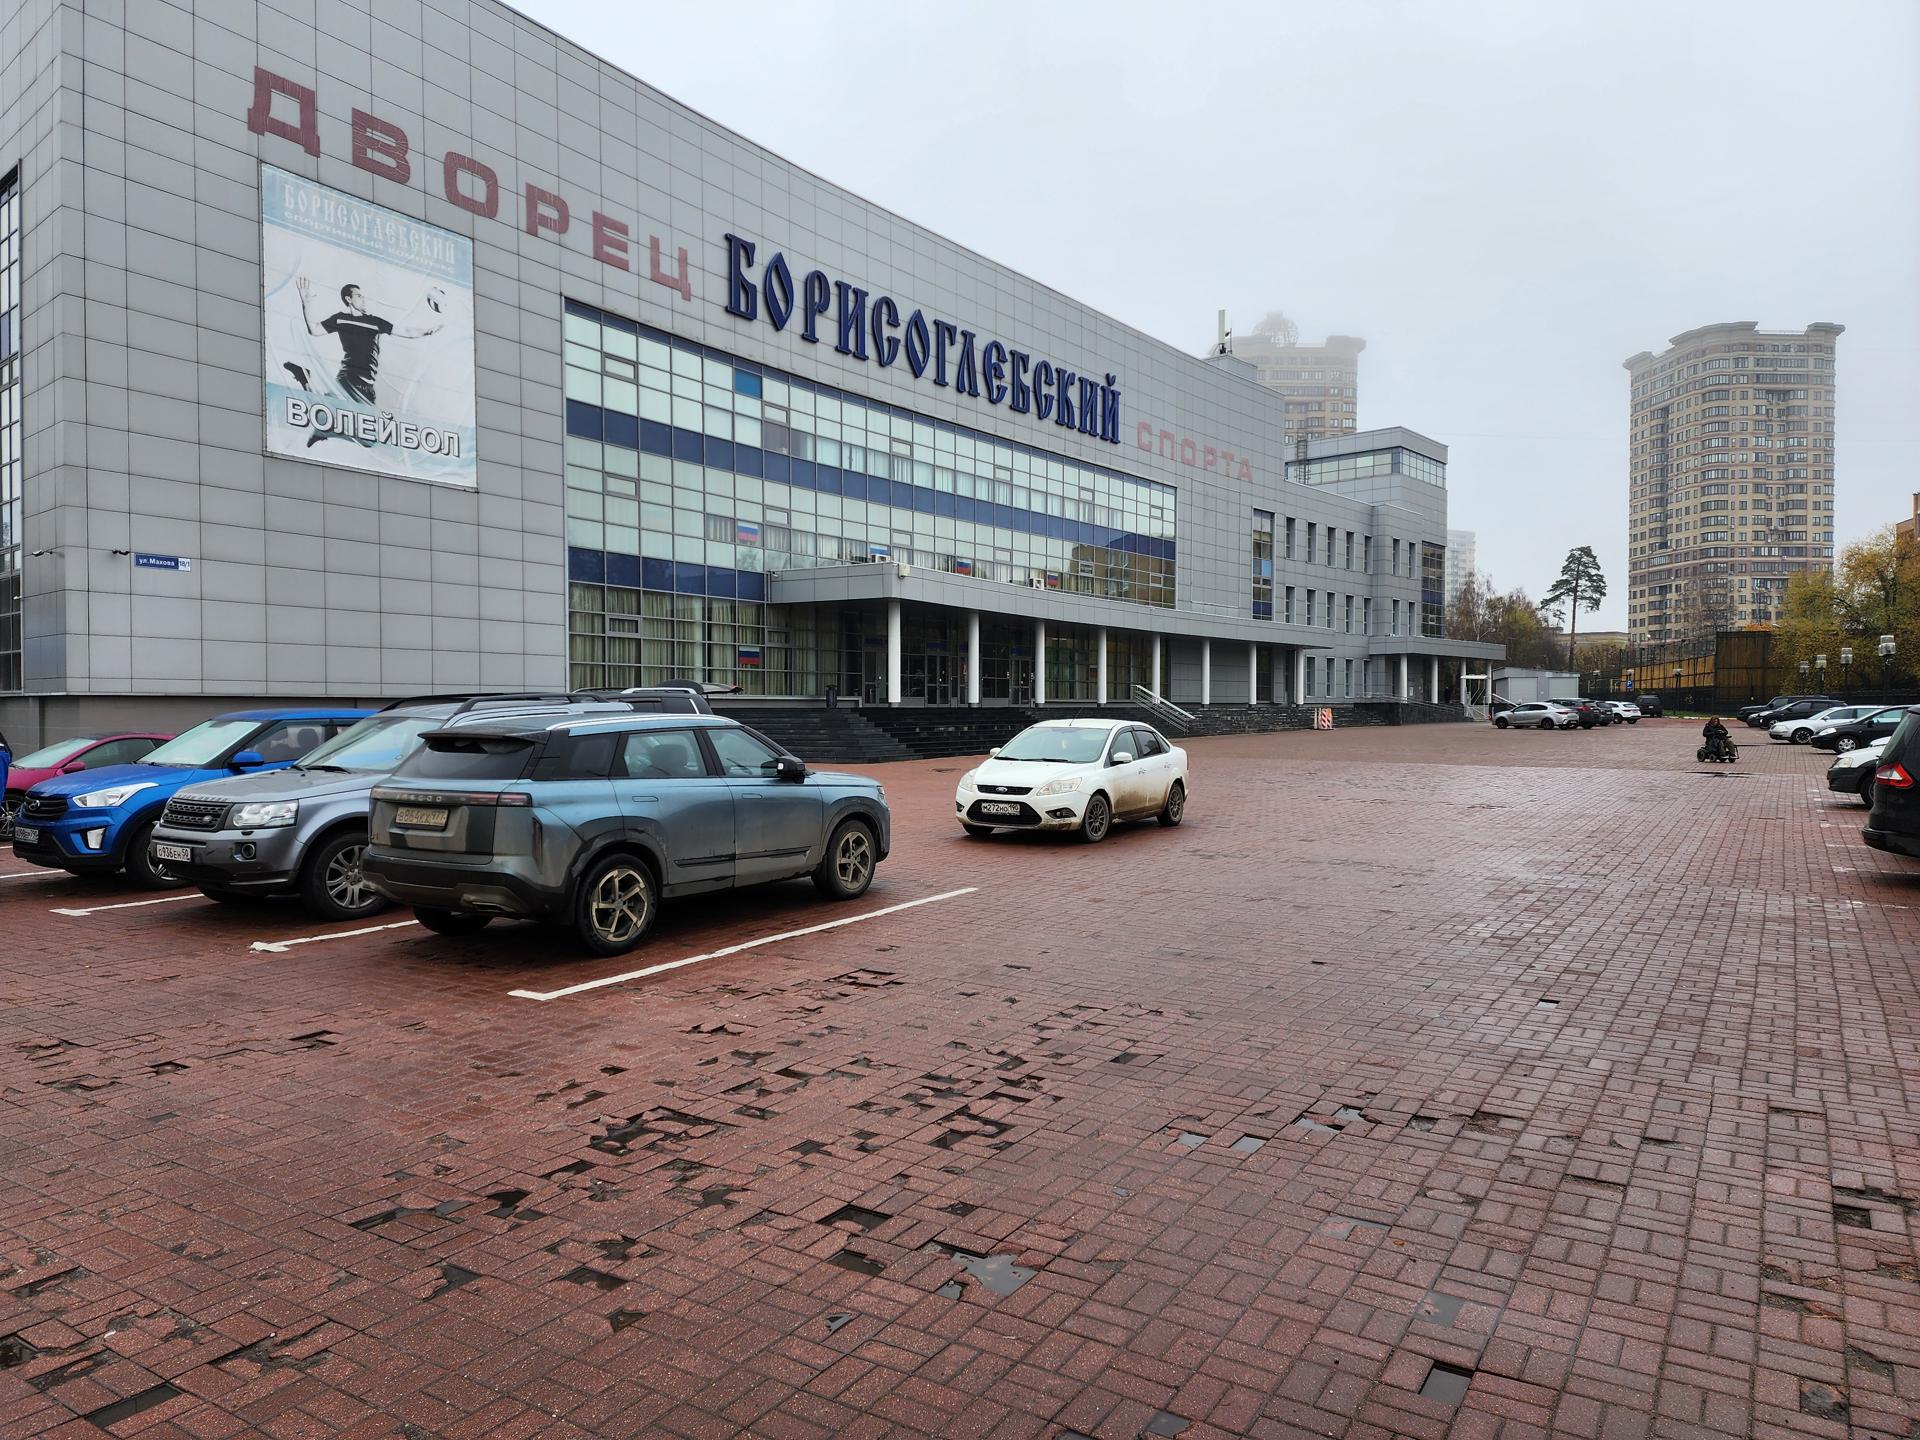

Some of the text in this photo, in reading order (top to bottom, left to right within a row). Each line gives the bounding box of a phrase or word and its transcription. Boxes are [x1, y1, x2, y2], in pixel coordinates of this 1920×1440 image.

[247, 65, 691, 302] ДВОРЕЦ
[724, 233, 1121, 444] БОРИСОГЛЕБСКИЙ
[286, 396, 460, 457] ВОЛЕЙБОЛ
[1136, 421, 1254, 483] СПОРТА
